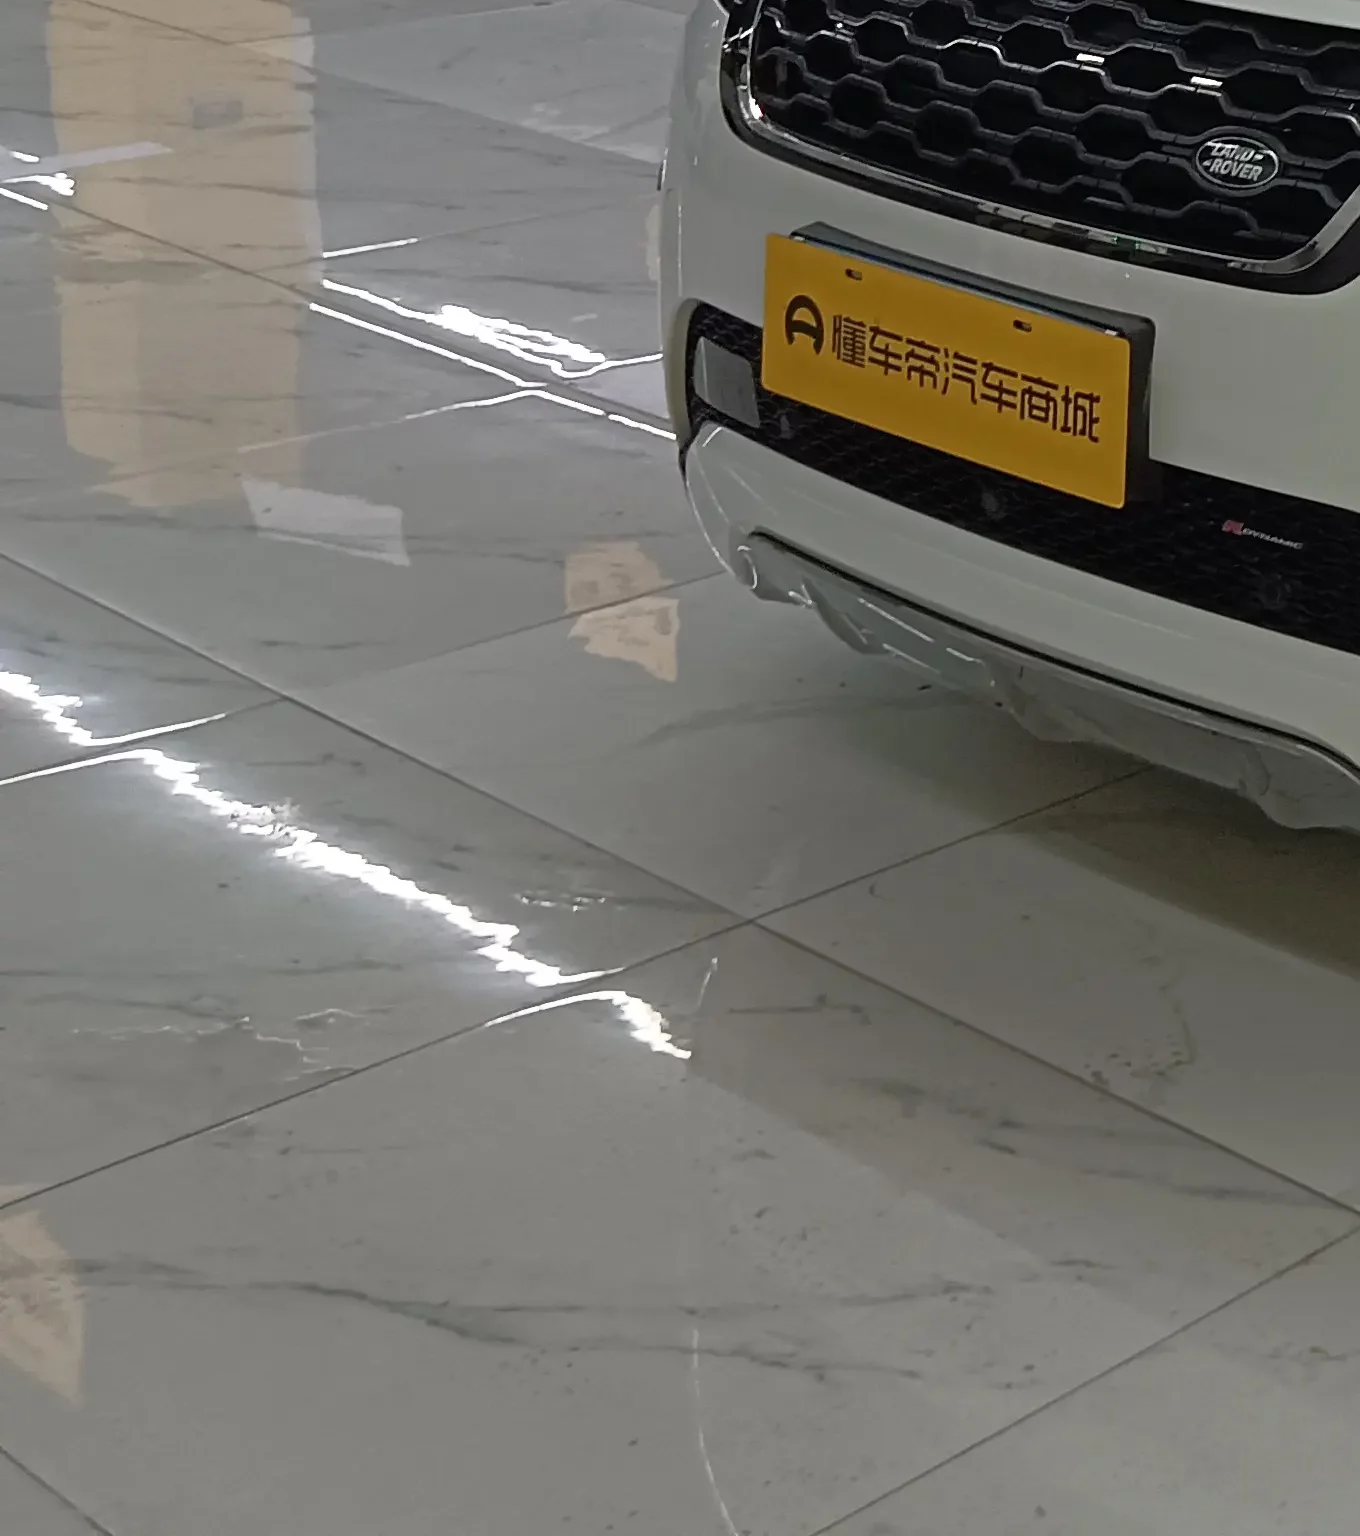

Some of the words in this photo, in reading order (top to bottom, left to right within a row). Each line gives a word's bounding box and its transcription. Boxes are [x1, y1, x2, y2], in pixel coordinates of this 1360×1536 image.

[1209, 158, 1263, 182] ROVER
[832, 314, 1101, 443] 懂车帝汽车商城
